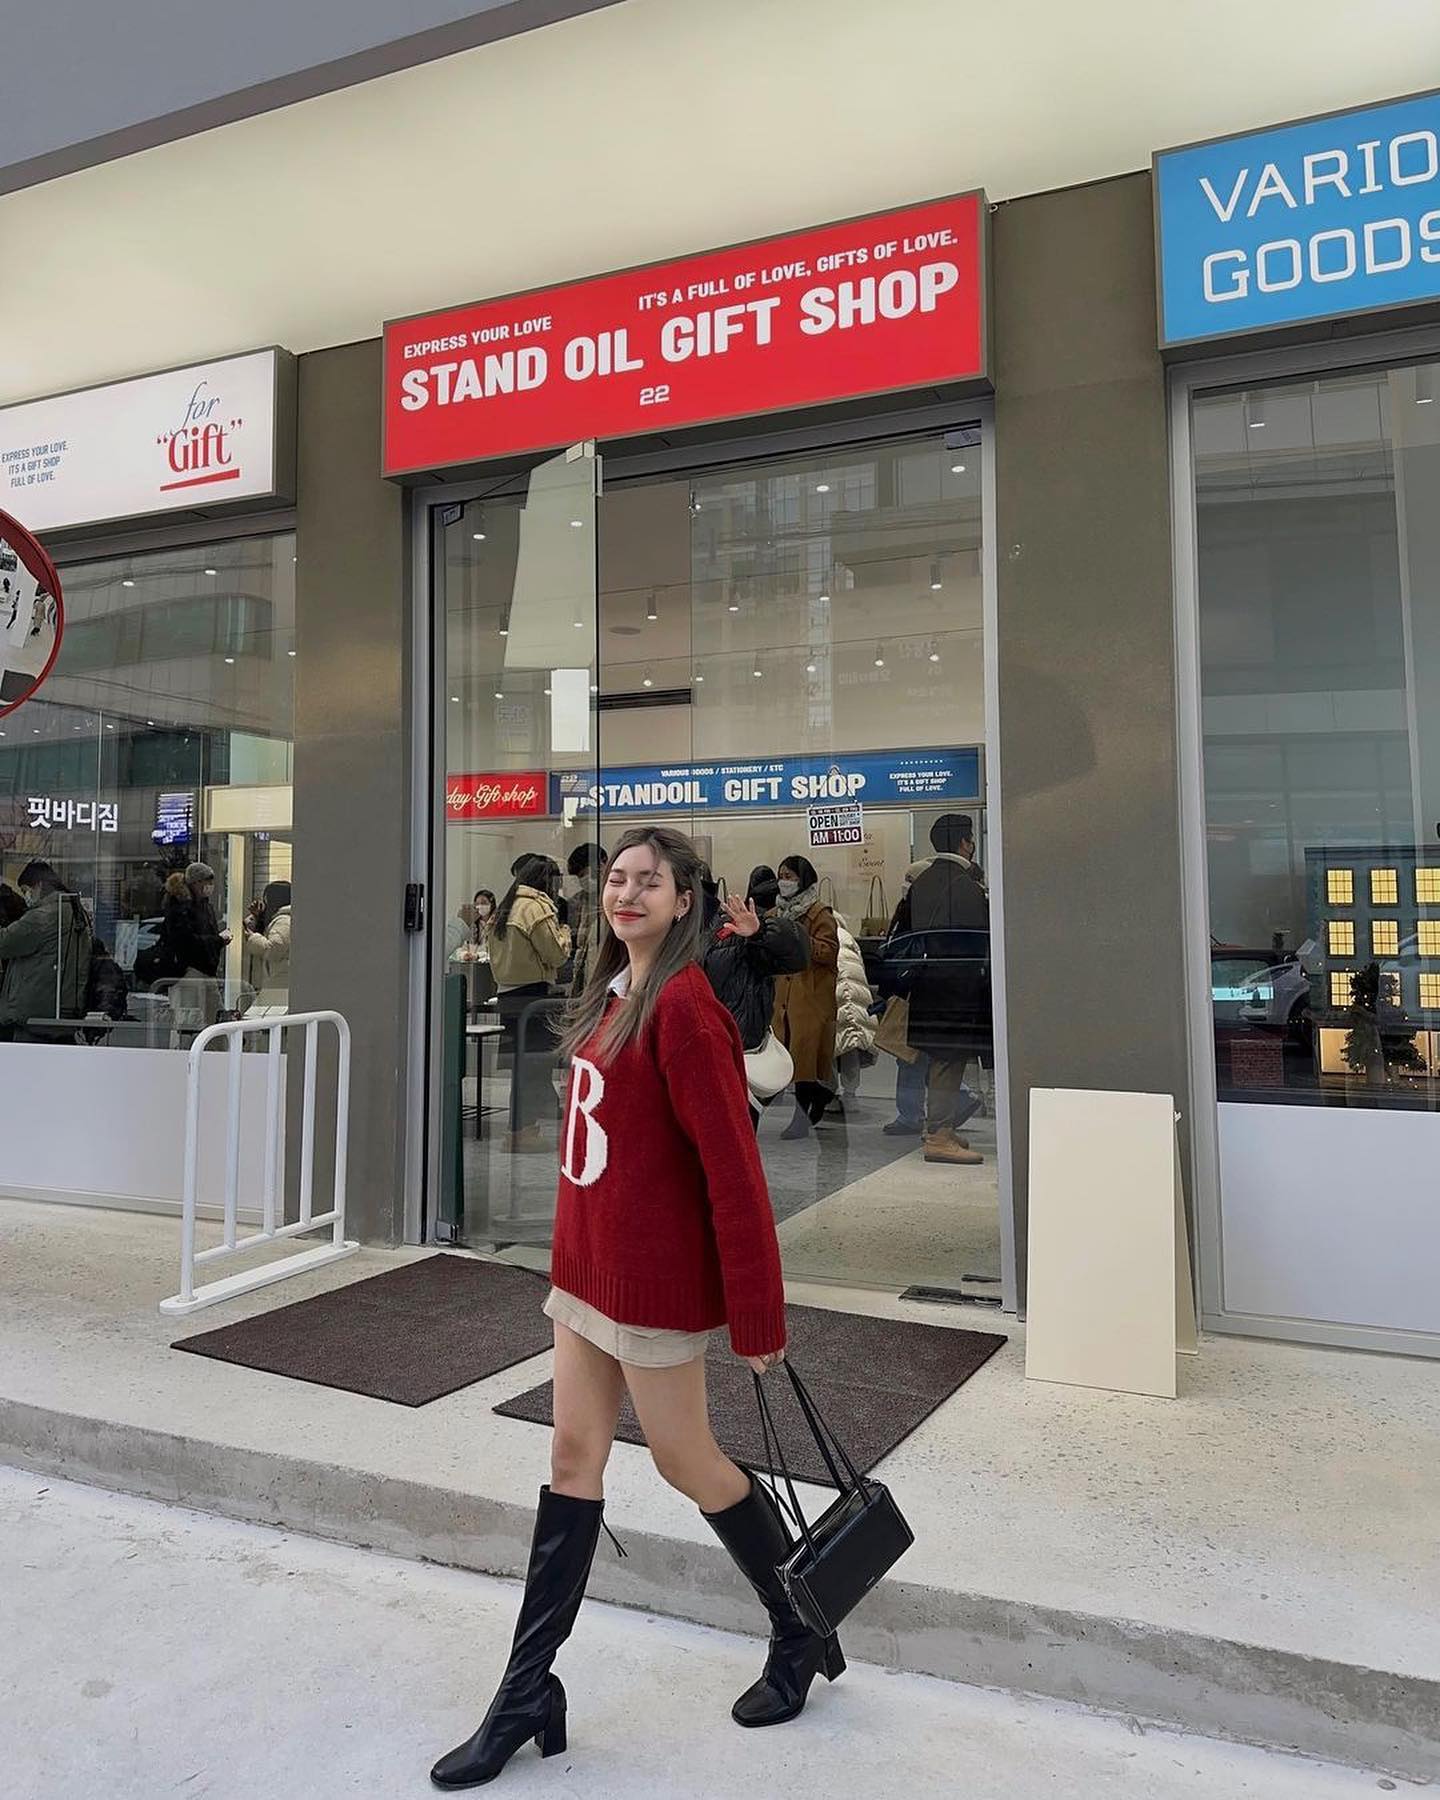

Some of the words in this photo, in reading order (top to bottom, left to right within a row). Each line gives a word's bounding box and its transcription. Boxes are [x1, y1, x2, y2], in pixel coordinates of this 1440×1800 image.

[1199, 130, 1439, 223] VARIO
[638, 290, 669, 311] IT'S
[671, 286, 684, 304] A
[687, 279, 731, 302] FULL
[734, 271, 757, 292] OF
[760, 261, 812, 286] LOVE,
[816, 247, 870, 273] GIFTS
[872, 242, 898, 261] OF
[902, 228, 959, 255] LOVE.
[400, 346, 548, 412] STAND
[563, 328, 645, 382] OIL
[660, 296, 782, 364] GIFT
[799, 261, 960, 336] SHOP
[403, 333, 468, 360] EXPRESS
[471, 324, 511, 348] YOUR
[513, 316, 553, 338] LOVE
[181, 381, 221, 430] for
[638, 385, 671, 406] 22
[1, 449, 31, 463] EXPRESS
[31, 445, 49, 457] YOUR
[27, 459, 42, 471] GIFT
[43, 456, 61, 468] SHOP
[11, 477, 26, 488] FULL
[27, 474, 36, 486] OF
[474, 783, 502, 810] Gift
[501, 783, 538, 810] shop
[724, 776, 784, 802] GIFT
[791, 773, 867, 800] SHOP
[809, 814, 839, 830] OPEN
[812, 831, 829, 845] AM
[832, 828, 860, 844] 11:00
[560, 1055, 608, 1188] B
